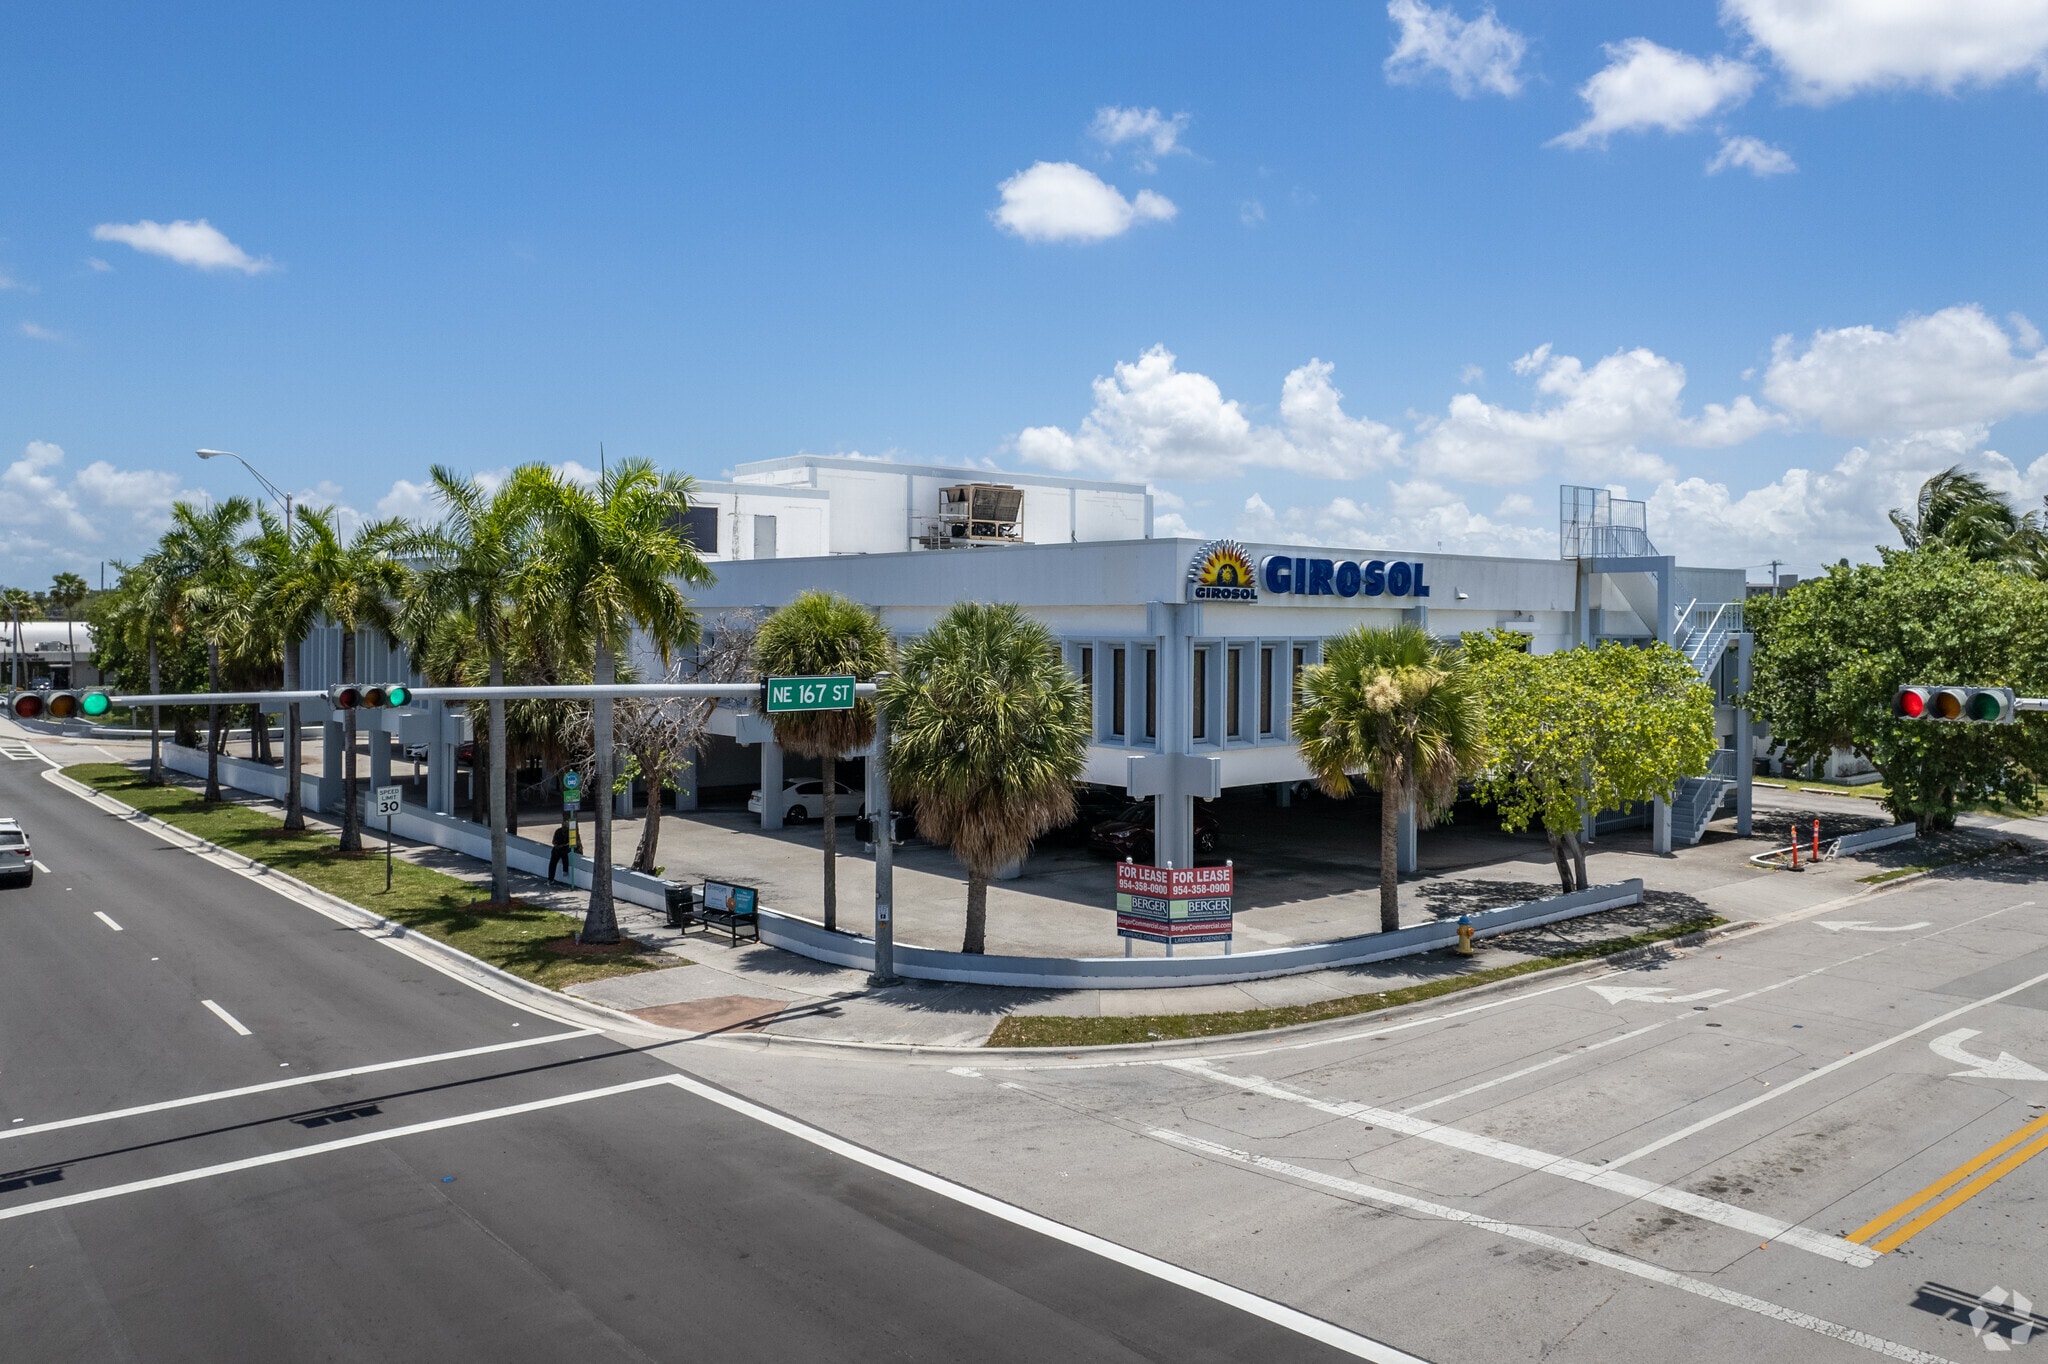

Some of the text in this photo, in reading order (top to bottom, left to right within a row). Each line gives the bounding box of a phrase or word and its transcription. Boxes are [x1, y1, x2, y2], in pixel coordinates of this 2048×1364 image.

[1264, 555, 1430, 598] GIROSOL
[1195, 587, 1258, 600] GIROSOL
[773, 684, 850, 704] NE 167 ST
[380, 801, 399, 813] 30
[1119, 865, 1168, 883] FOR LEASE
[1173, 869, 1230, 883] FOR LEASE
[1119, 878, 1168, 895] 954-358-0900
[1173, 883, 1230, 895] 954-358-0900
[1132, 897, 1167, 914] BERGER
[1188, 900, 1229, 912] BERGER
[1117, 917, 1169, 931] BergerCommercial.com
[1170, 922, 1231, 932] BergerCommercial.com
